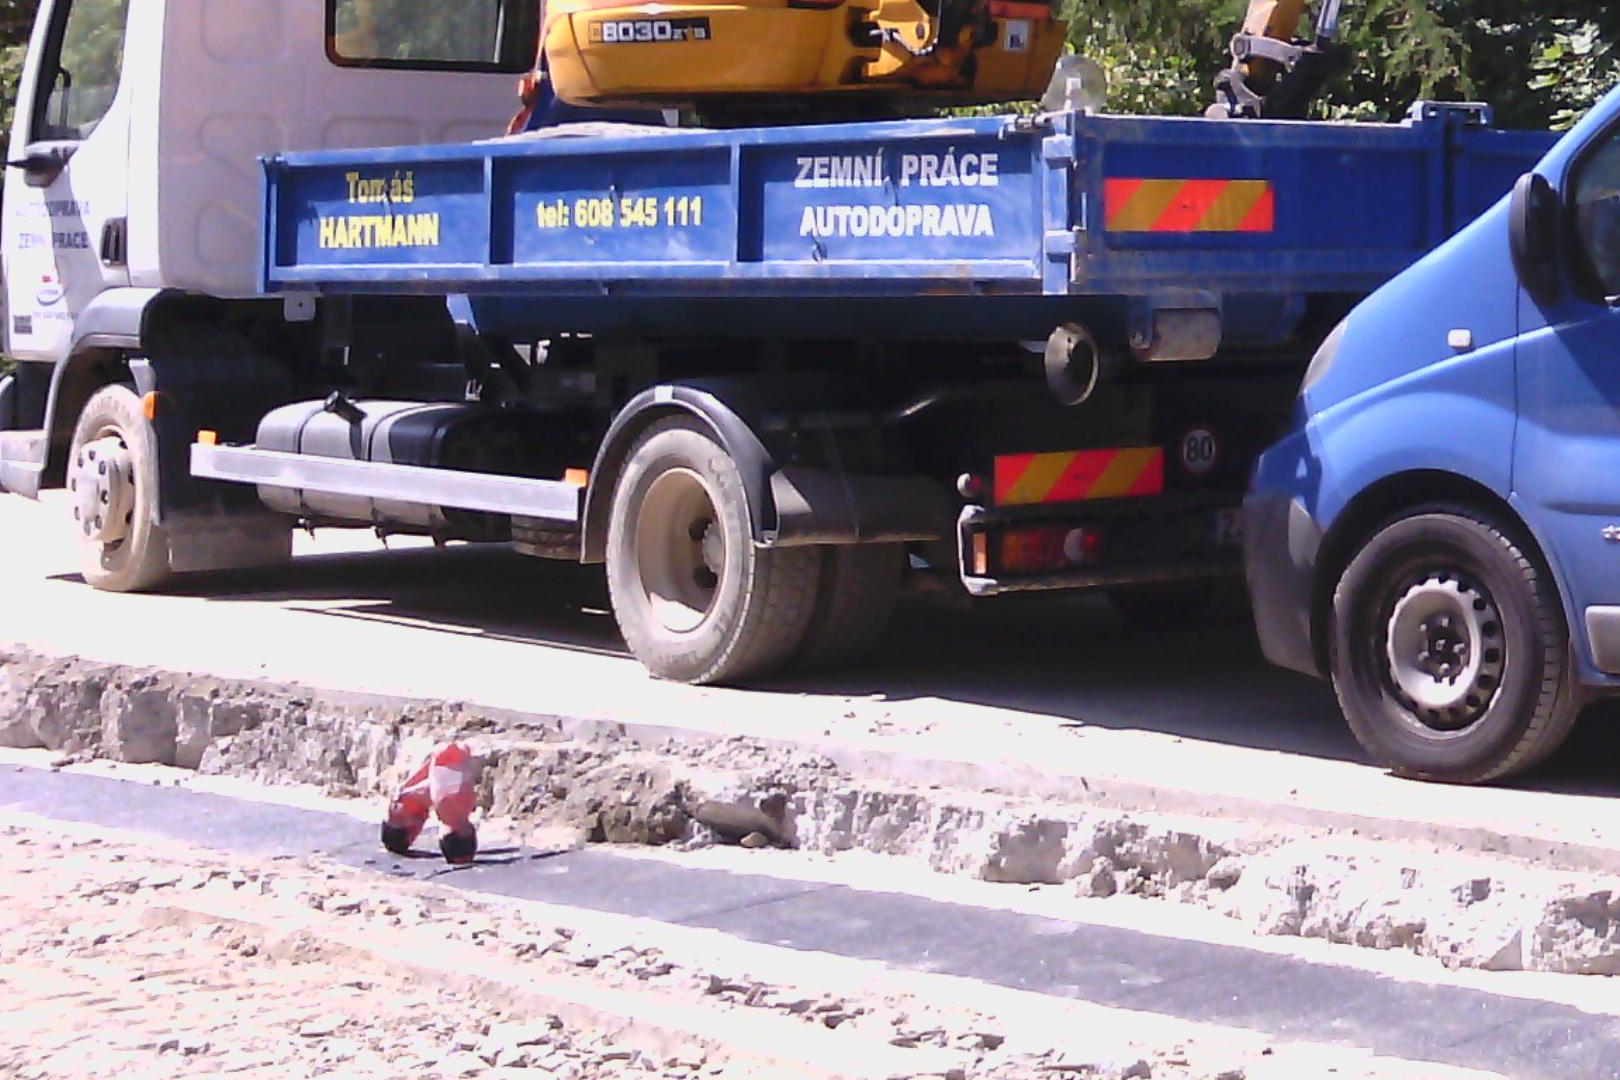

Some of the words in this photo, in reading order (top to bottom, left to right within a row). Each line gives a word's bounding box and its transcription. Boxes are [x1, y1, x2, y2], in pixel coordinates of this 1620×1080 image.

[794, 146, 884, 188] ZEMNÍ
[900, 145, 999, 187] PRÁCE
[536, 200, 569, 228] tel:
[574, 198, 614, 228] 608
[619, 197, 658, 228] 545
[664, 196, 701, 226] 111
[799, 204, 995, 237] AUTODOPRAVA
[319, 213, 440, 249] HARTMANN
[1186, 436, 1213, 461] 80
